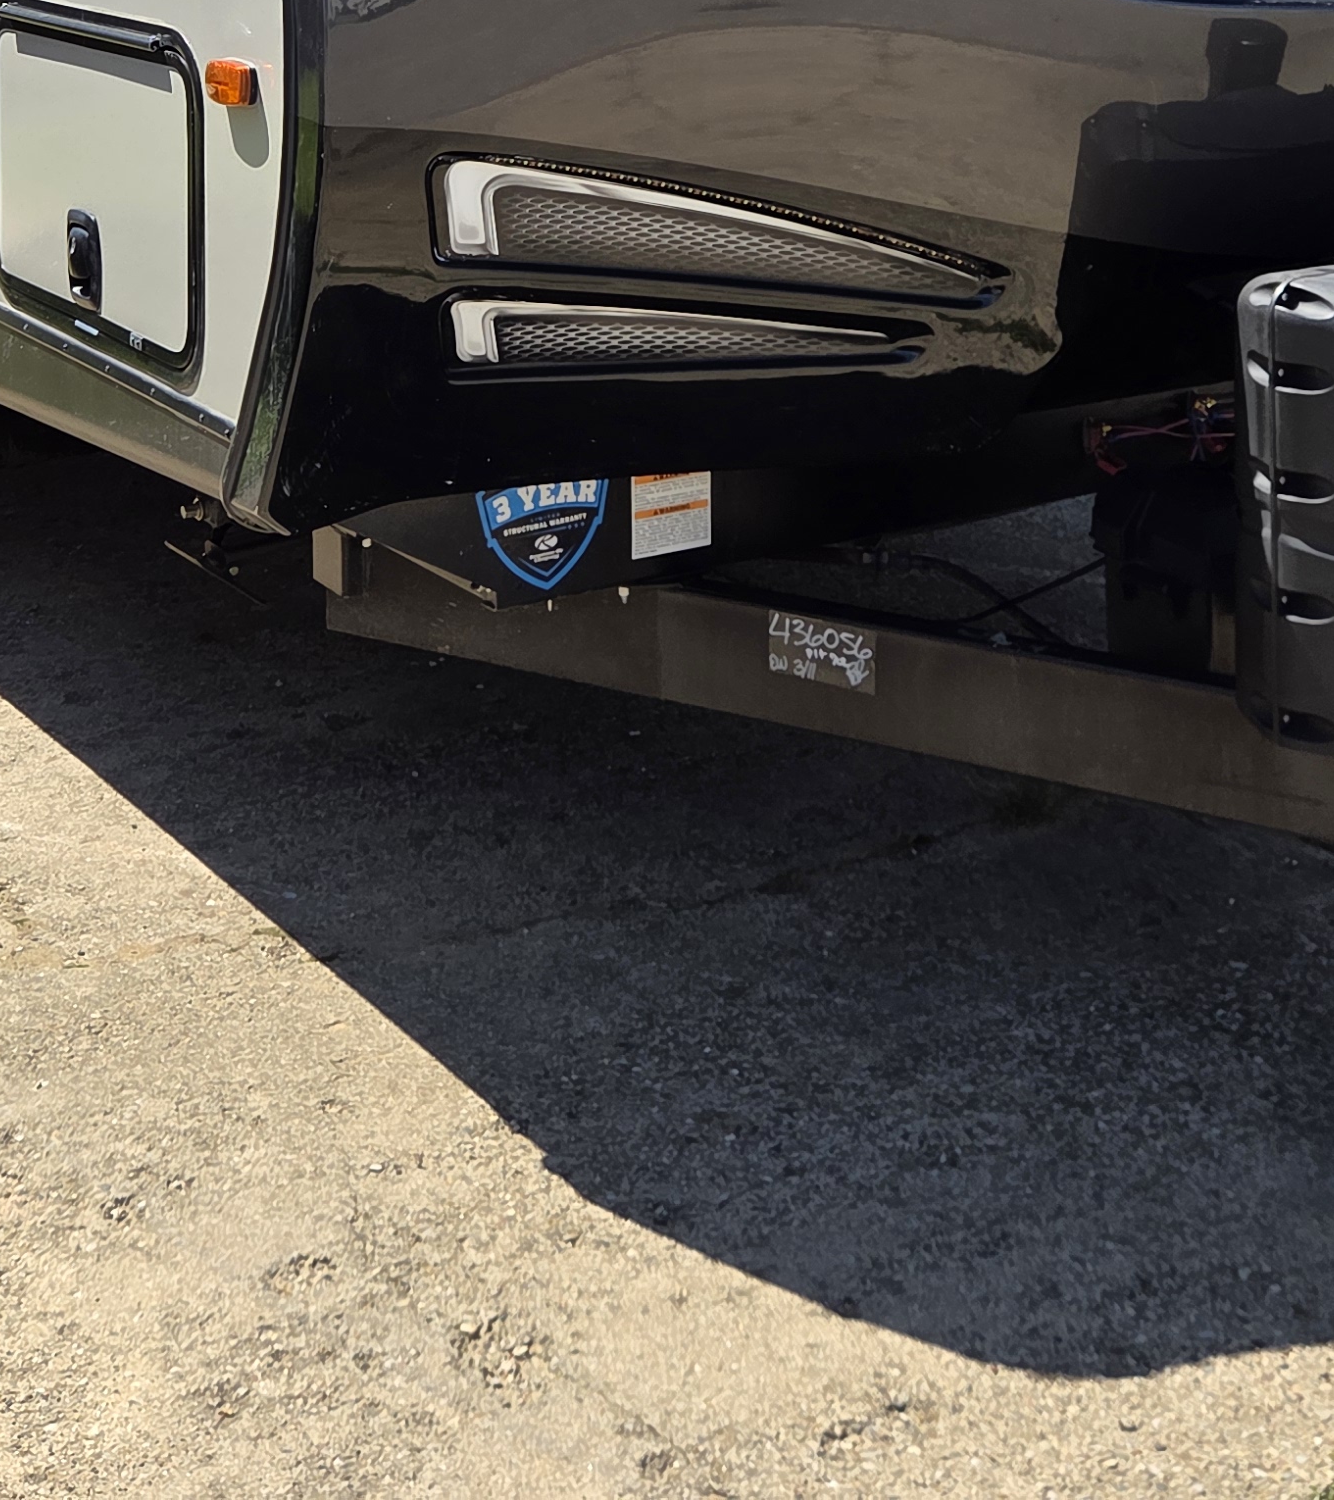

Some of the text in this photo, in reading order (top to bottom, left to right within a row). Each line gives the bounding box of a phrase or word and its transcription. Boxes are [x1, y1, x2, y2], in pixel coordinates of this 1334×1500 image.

[492, 479, 597, 523] 3 YEAR
[503, 512, 588, 538] STRUCTURAL WARRANTY
[768, 612, 873, 660] 436056
